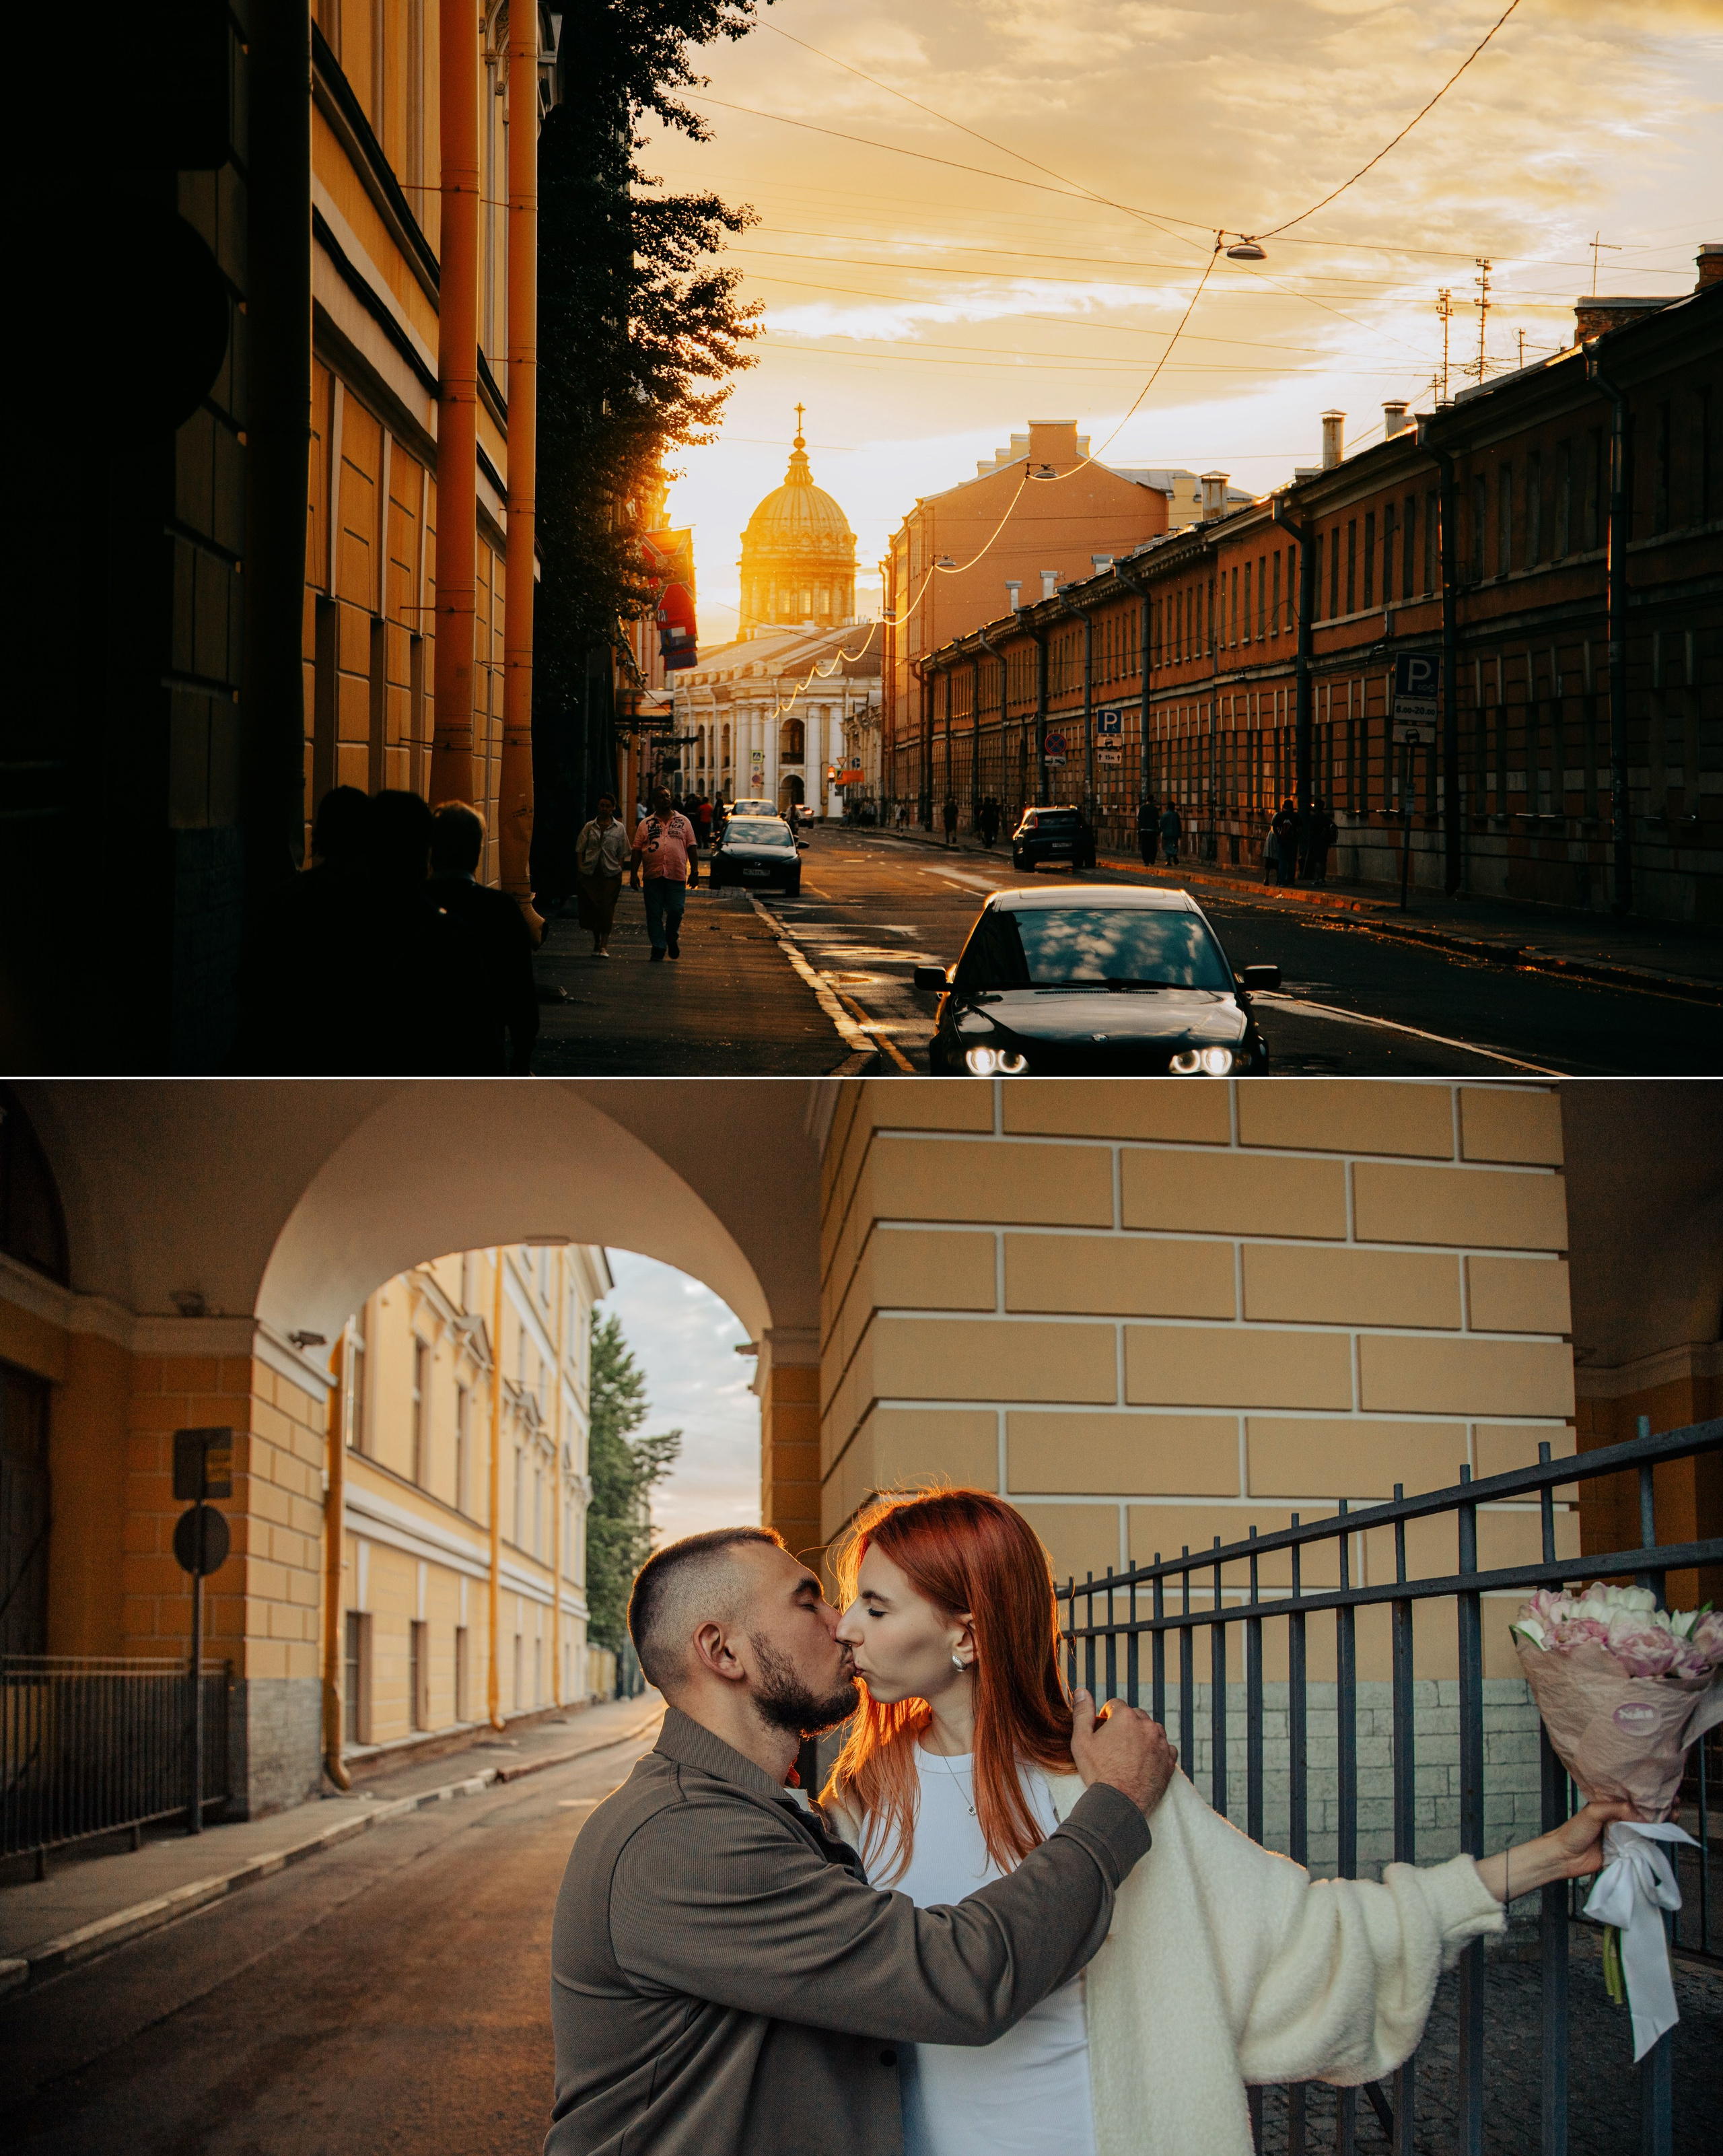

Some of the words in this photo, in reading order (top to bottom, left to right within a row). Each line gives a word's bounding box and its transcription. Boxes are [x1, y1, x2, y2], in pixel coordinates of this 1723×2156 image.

[1407, 658, 1432, 691] P
[1396, 705, 1436, 716] 8.00-20.00
[1104, 712, 1118, 732] P
